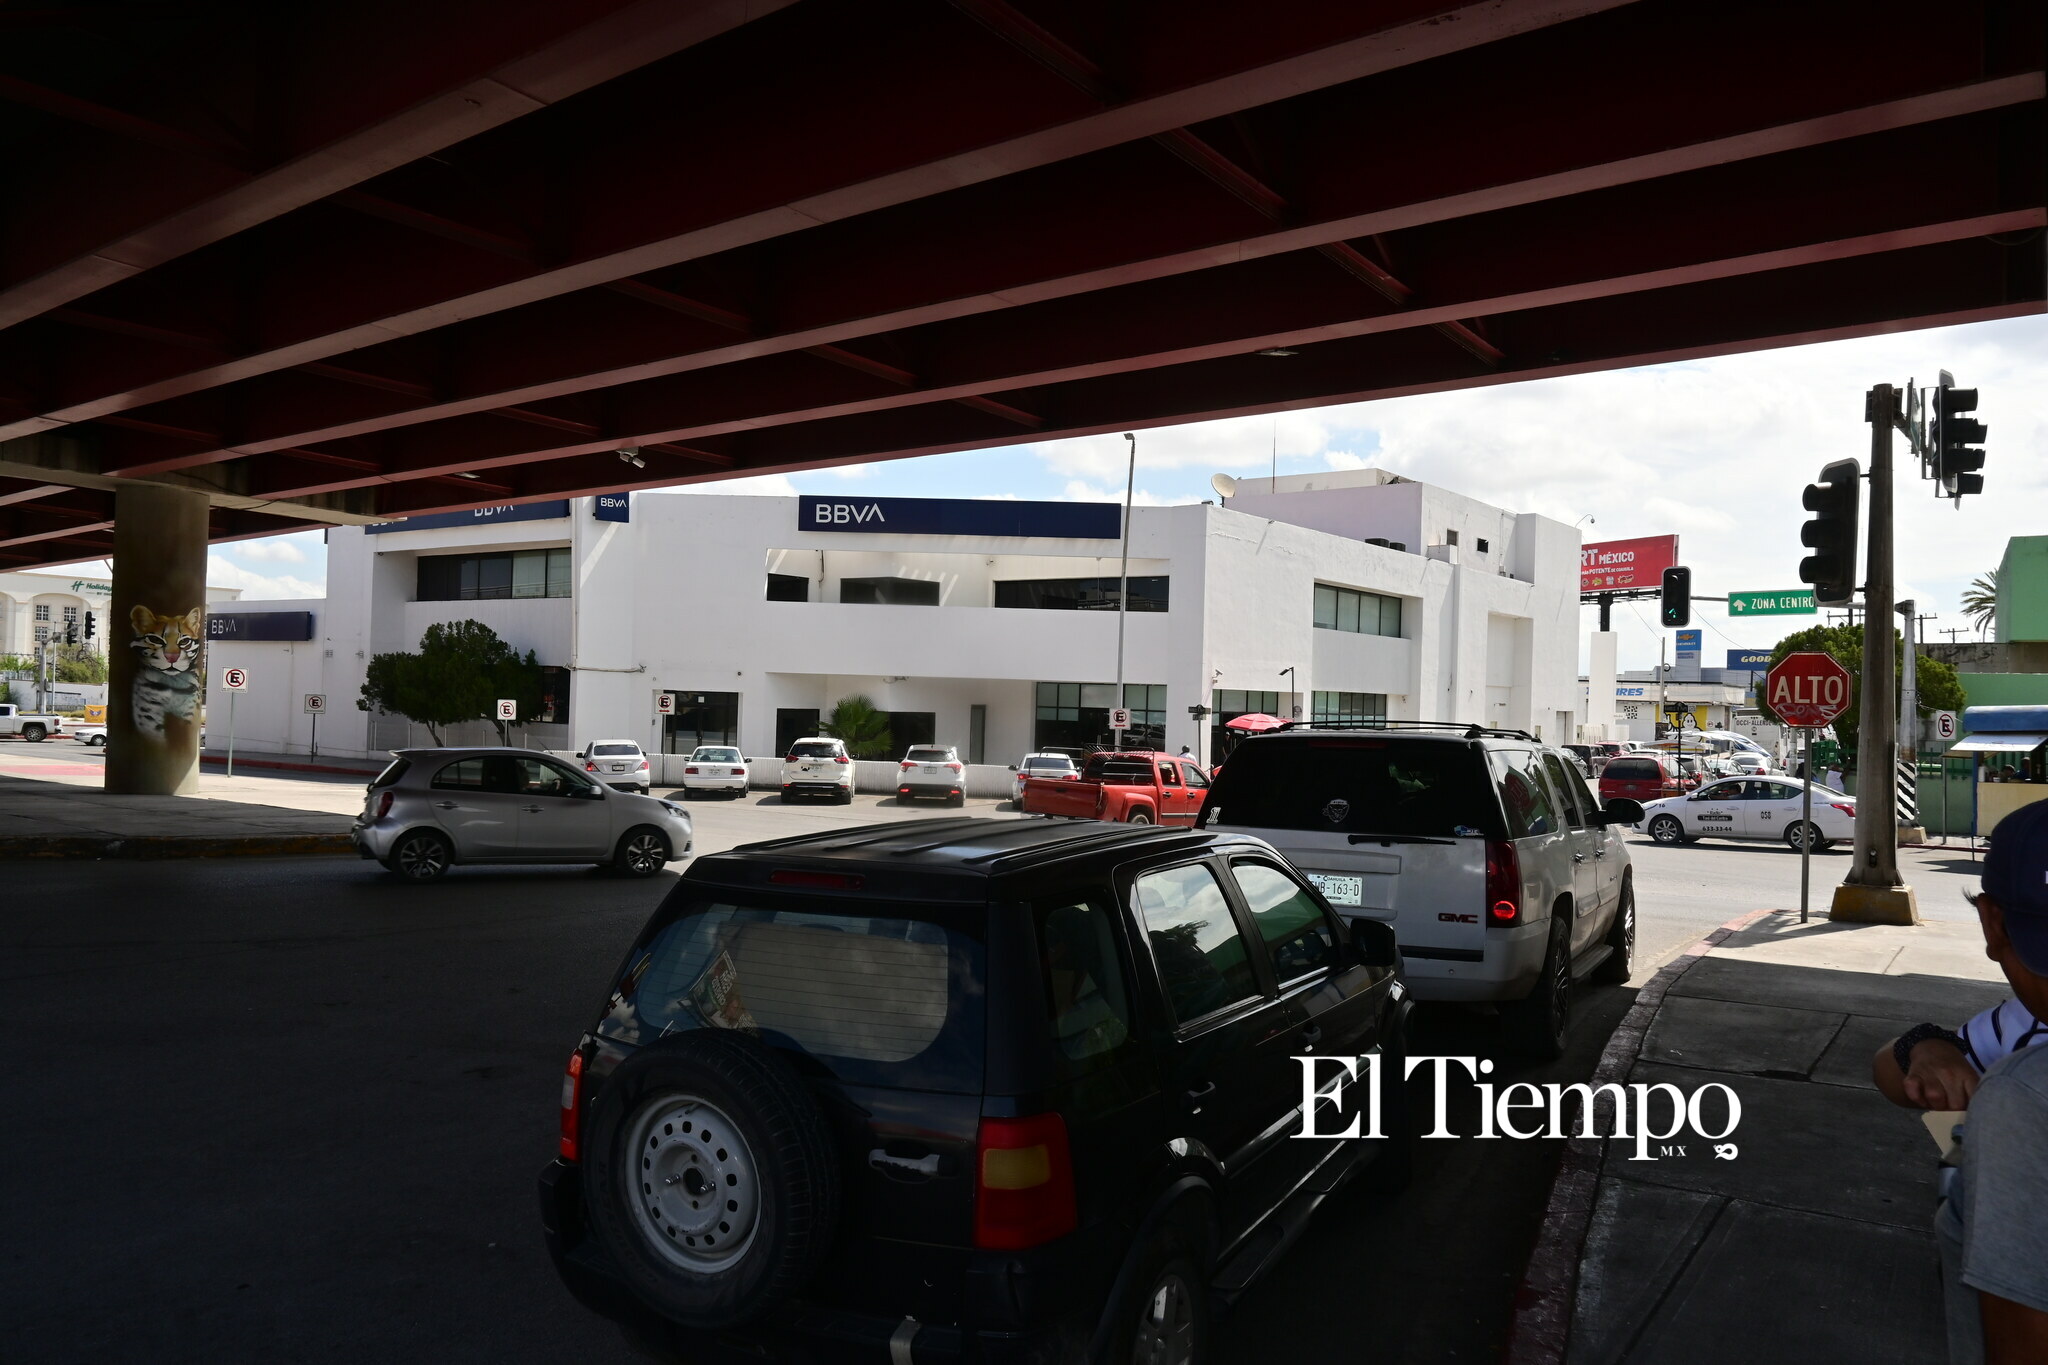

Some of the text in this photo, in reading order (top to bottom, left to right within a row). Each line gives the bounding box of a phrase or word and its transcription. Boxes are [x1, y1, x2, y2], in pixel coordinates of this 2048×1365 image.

[600, 497, 627, 508] BBVA
[815, 502, 886, 524] BBVA
[1598, 551, 1635, 565] MÉXICO
[1751, 596, 1814, 609] ZONA CENTRO
[211, 618, 237, 634] BBVA
[1773, 675, 1843, 704] ALTO
[1760, 811, 1771, 820] 058
[1311, 880, 1360, 896] B-163-D
[1438, 912, 1478, 924] GMC
